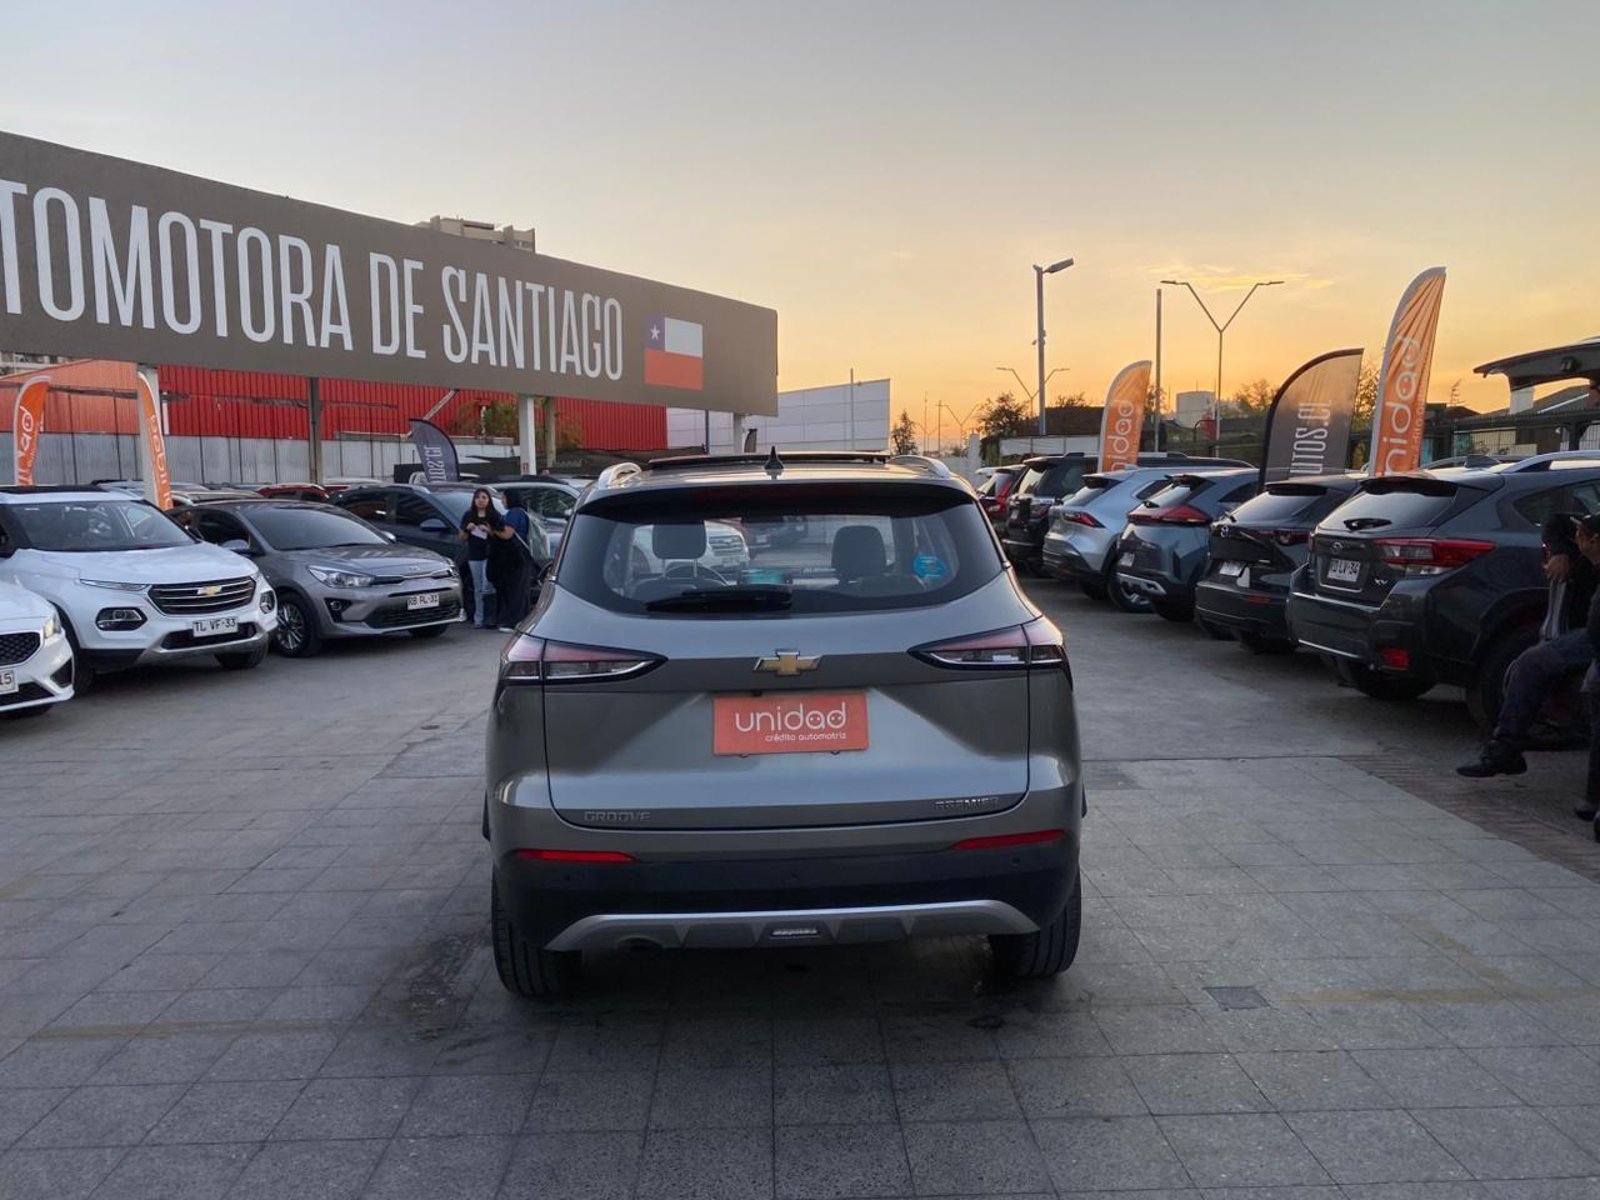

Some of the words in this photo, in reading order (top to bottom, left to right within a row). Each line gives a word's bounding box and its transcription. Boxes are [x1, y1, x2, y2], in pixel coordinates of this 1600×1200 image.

[0, 179, 353, 351] TOMOTORA
[369, 251, 427, 359] DE
[441, 265, 623, 381] SANTIAGO
[1289, 400, 1332, 474] UTOS.CL
[735, 701, 847, 732] unidad
[765, 733, 796, 742] crédito
[799, 731, 847, 741] automotriz
